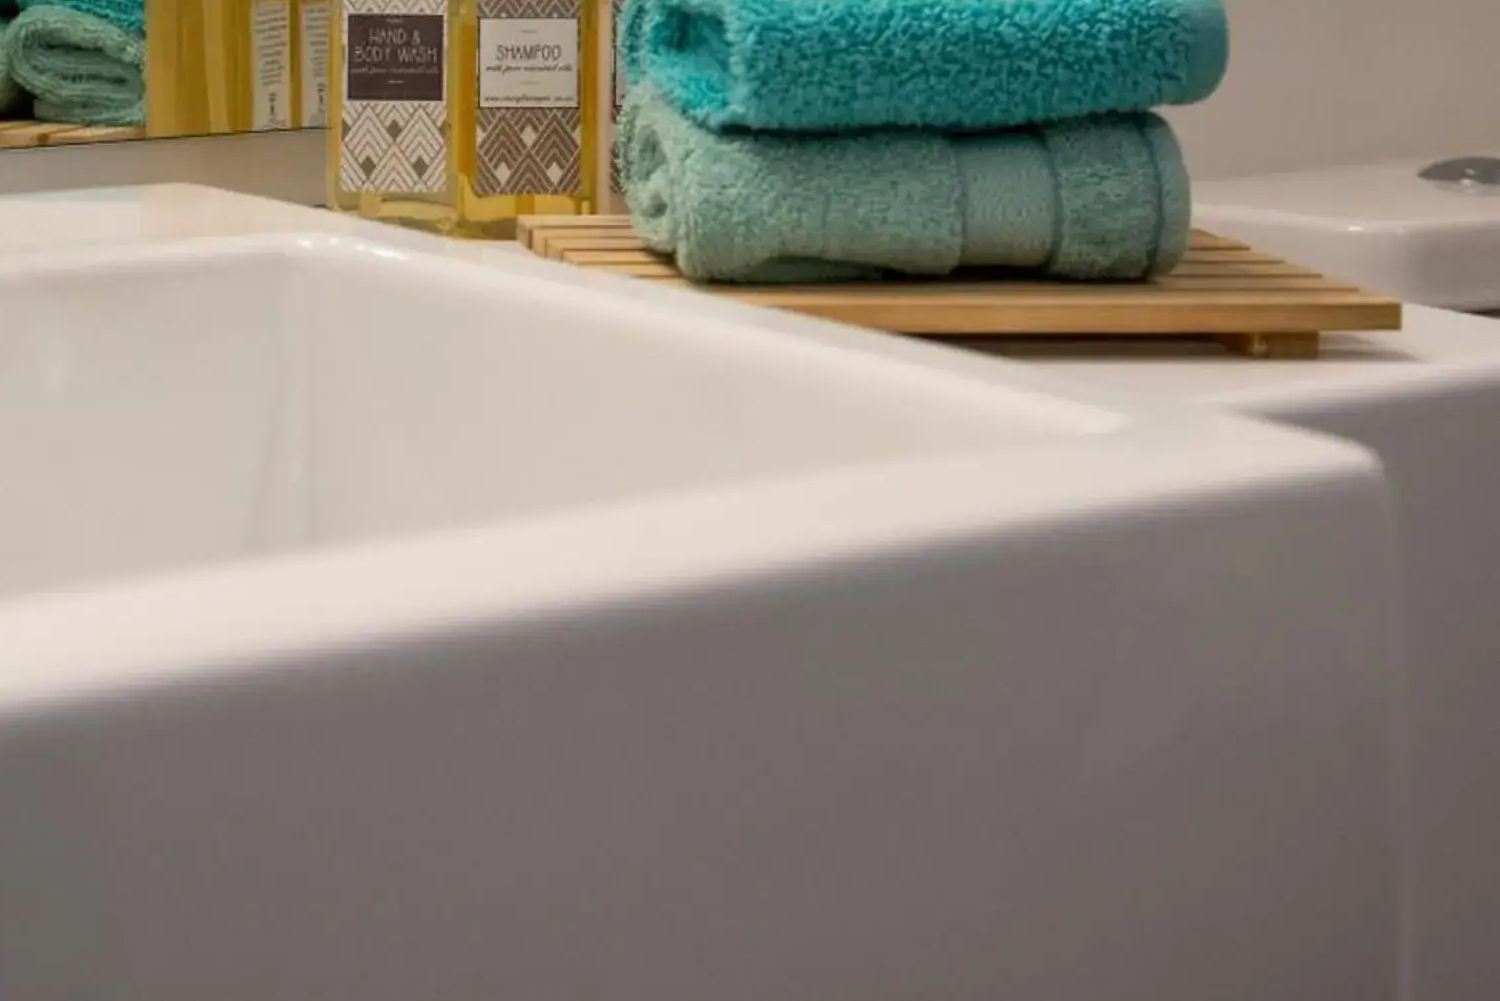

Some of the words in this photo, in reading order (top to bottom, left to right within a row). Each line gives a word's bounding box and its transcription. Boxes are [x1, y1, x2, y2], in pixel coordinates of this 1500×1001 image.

[369, 27, 407, 44] HAND
[411, 29, 421, 46] &
[355, 45, 391, 62] BODY
[397, 45, 437, 63] WASH
[496, 44, 562, 61] SHAMPOO
